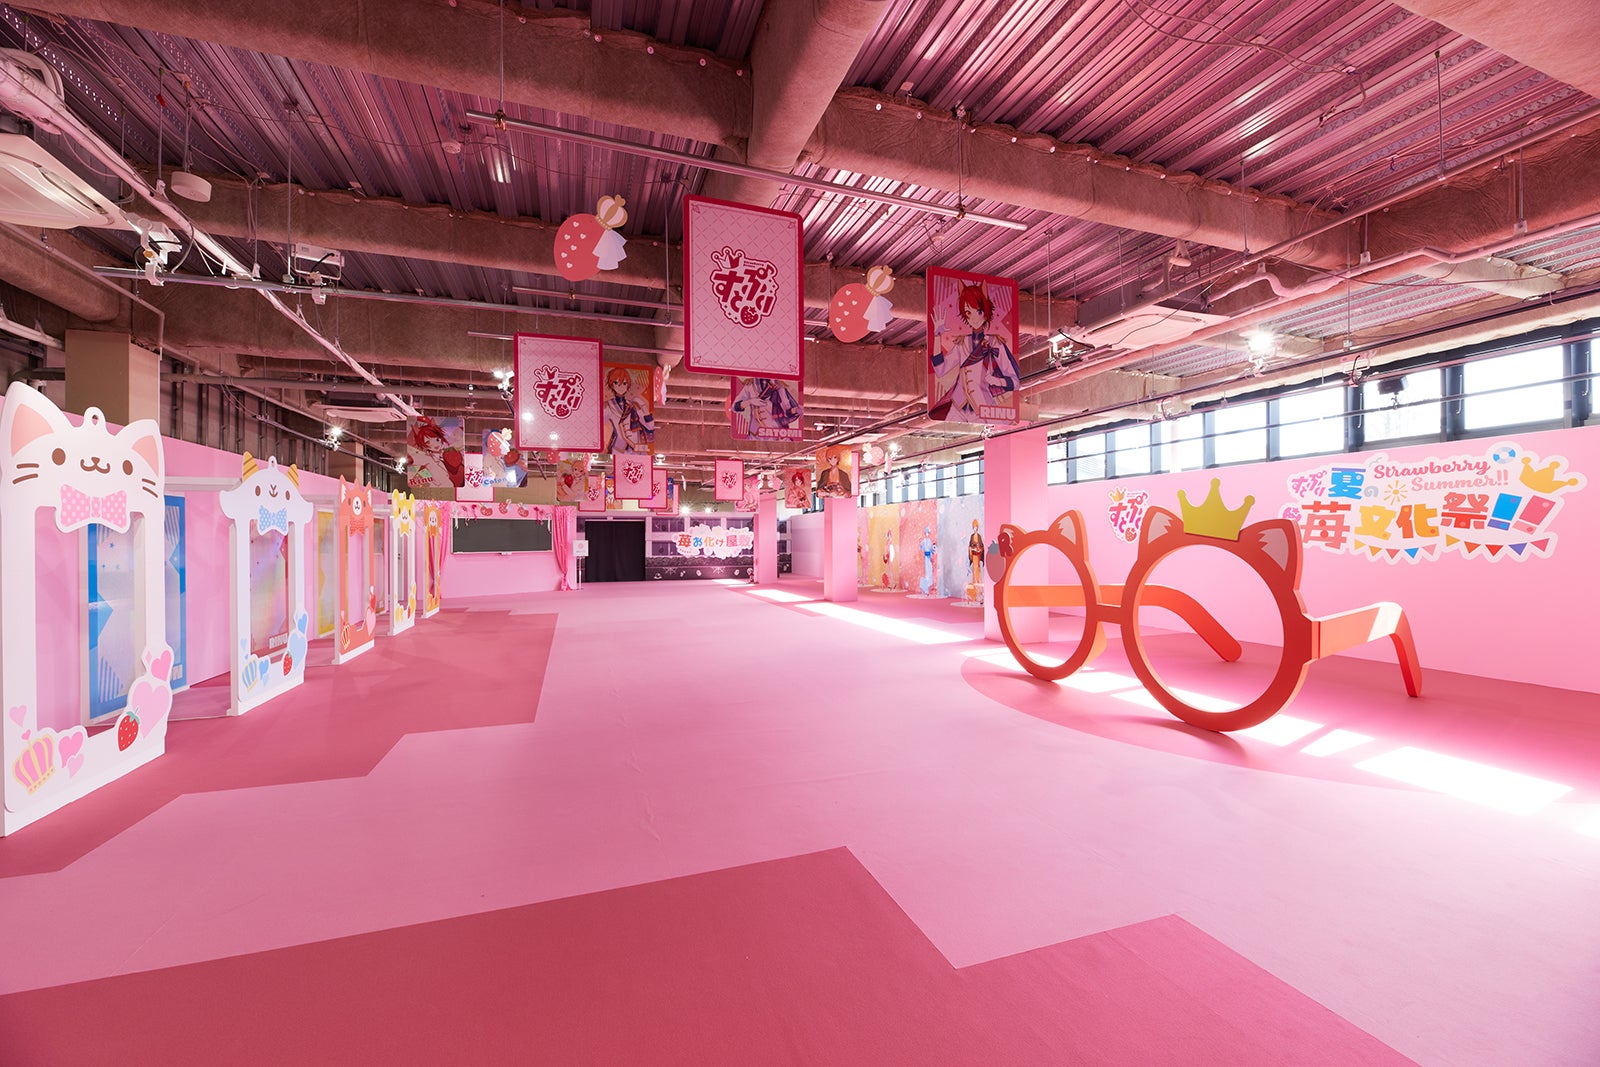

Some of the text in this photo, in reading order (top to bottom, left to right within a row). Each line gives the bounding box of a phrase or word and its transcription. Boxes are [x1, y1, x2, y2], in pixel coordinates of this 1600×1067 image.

[980, 407, 1016, 420] RINU
[758, 429, 802, 438] SATOMI
[1373, 460, 1491, 479] Strawberry
[1411, 469, 1509, 492] Summer!!
